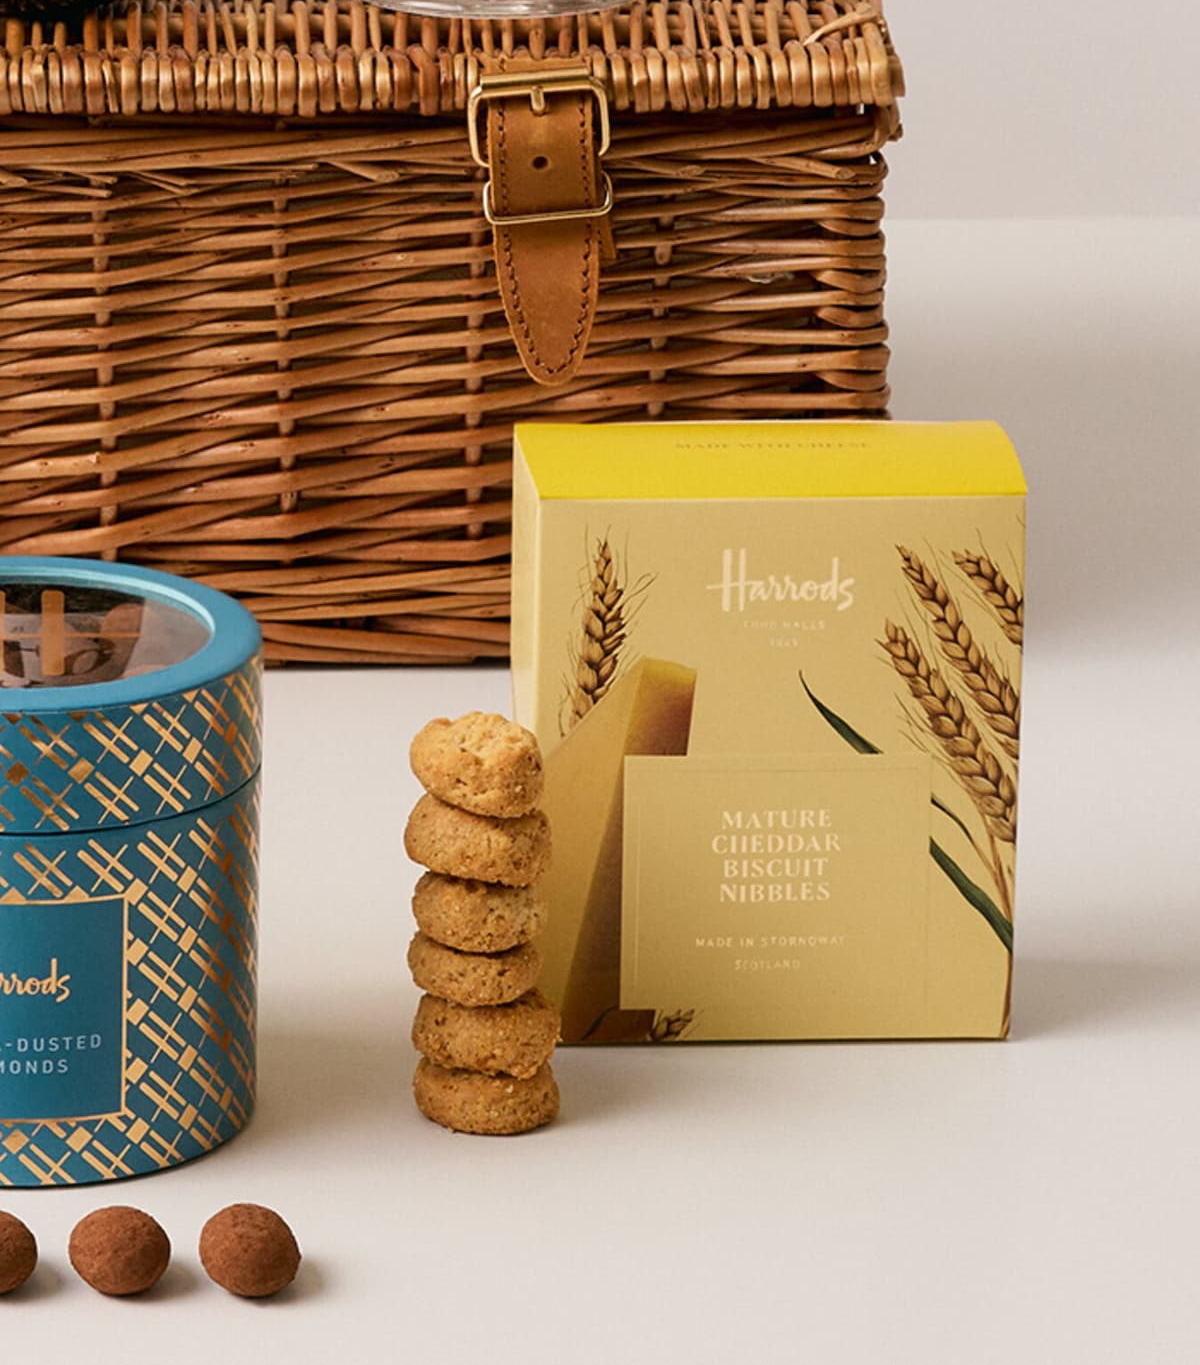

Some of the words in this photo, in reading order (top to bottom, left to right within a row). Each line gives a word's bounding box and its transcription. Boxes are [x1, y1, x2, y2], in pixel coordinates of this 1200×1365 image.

[705, 548, 855, 613] Harrods
[721, 809, 833, 830] MATURE
[711, 833, 841, 854] CHEDDAR
[723, 857, 829, 878] BISCUIT
[719, 881, 832, 903] NIBBLES
[695, 937, 733, 948] MADE
[740, 937, 754, 948] IN
